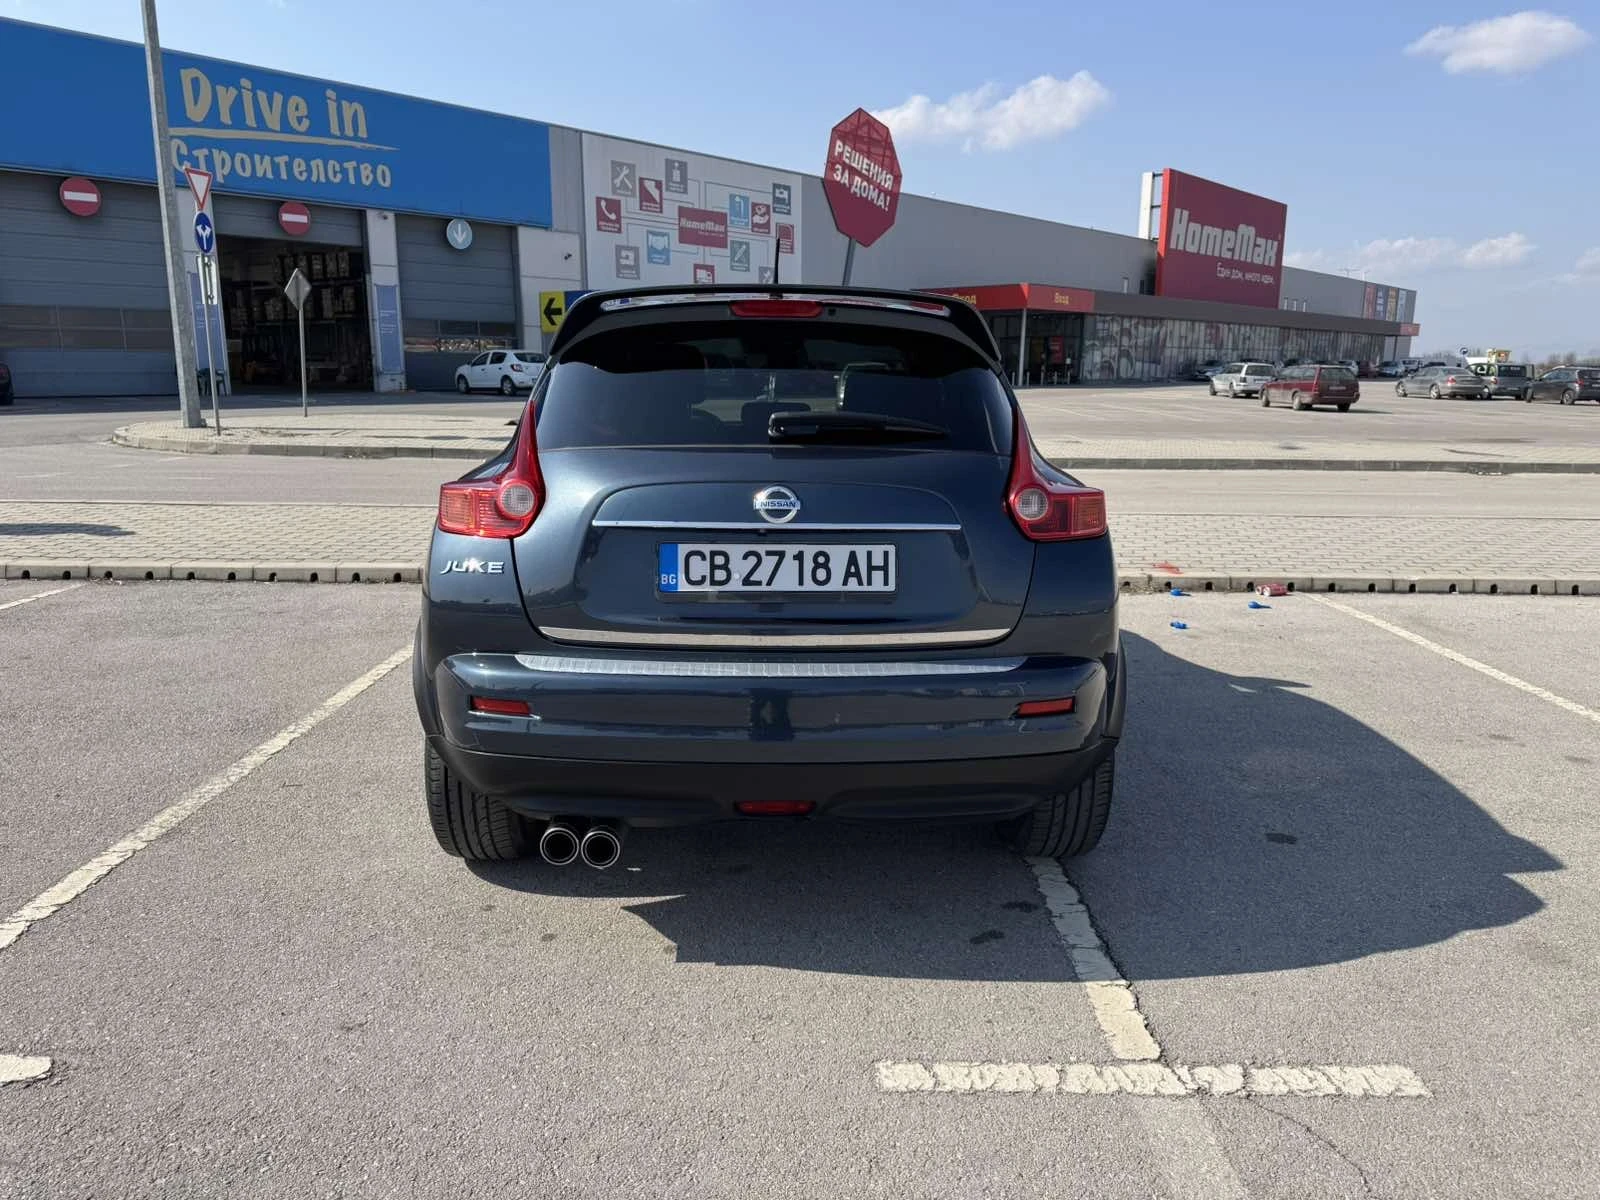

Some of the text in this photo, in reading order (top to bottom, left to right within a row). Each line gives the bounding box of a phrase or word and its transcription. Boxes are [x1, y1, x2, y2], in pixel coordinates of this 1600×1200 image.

[180, 67, 368, 138] Drive in
[171, 138, 392, 188] Строителство
[834, 140, 894, 190] РЕШЕНИЯ
[833, 164, 890, 211] ЗА ДОМА!
[1169, 207, 1278, 267] HomeMax
[760, 500, 796, 508] NISSAN
[440, 558, 504, 574] JUKE
[661, 574, 677, 585] BG
[683, 550, 889, 587] CB 2718 AH
